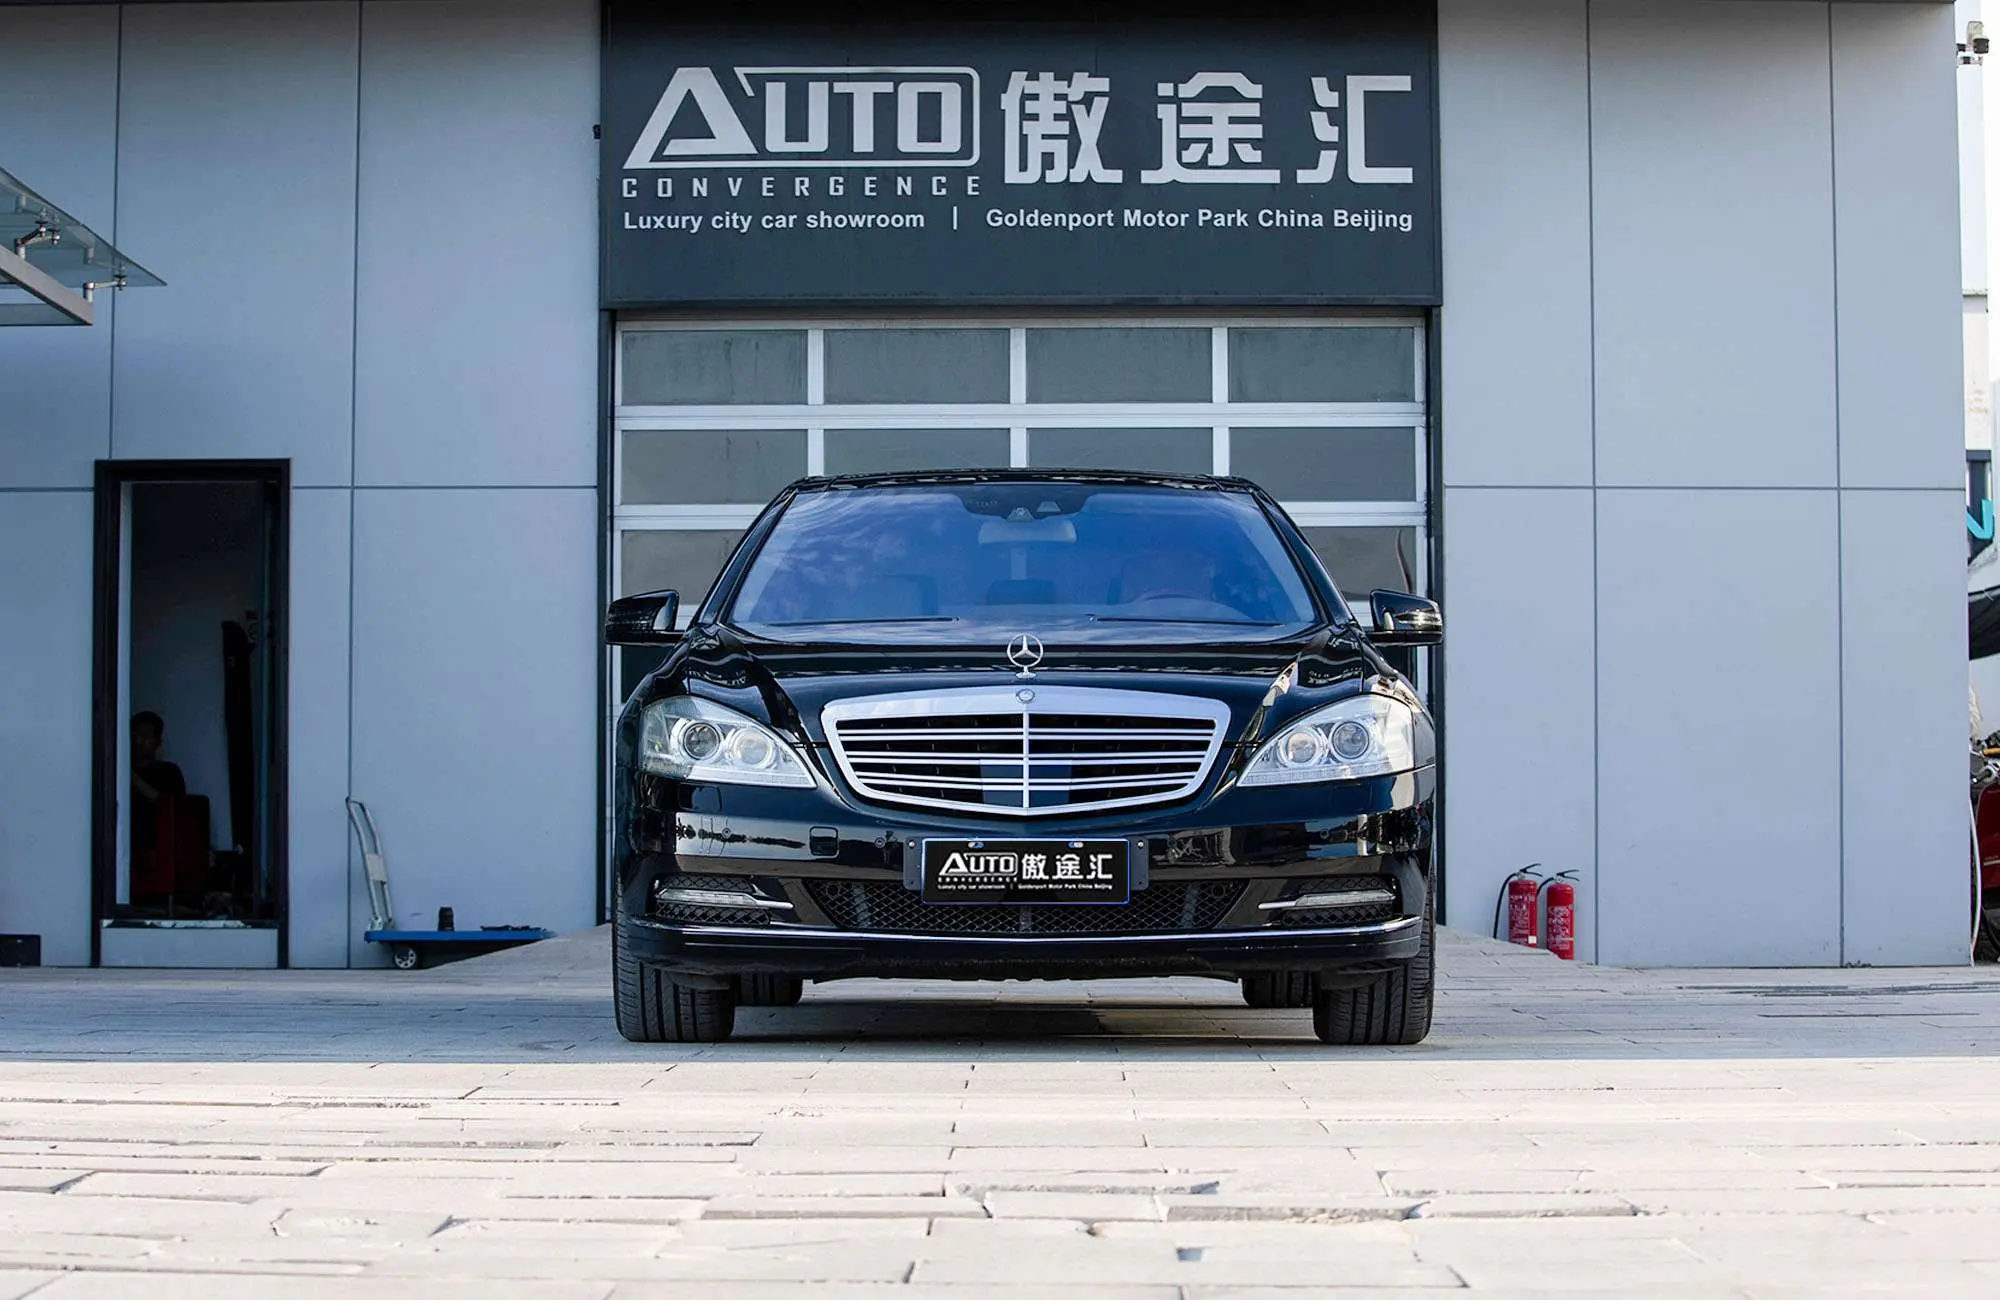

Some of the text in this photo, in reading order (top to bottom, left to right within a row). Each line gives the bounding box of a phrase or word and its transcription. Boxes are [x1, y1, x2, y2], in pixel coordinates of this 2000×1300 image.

[622, 67, 963, 169] AUTO
[1001, 72, 1413, 184] 傲途汇
[622, 175, 981, 198] CONVERGENCE
[624, 210, 926, 234] Luxury city car showroom
[986, 208, 1413, 233] Goldenport Motor Park China Beijing
[939, 852, 1017, 876] AUTO
[1021, 853, 1113, 880] 傲途汇
